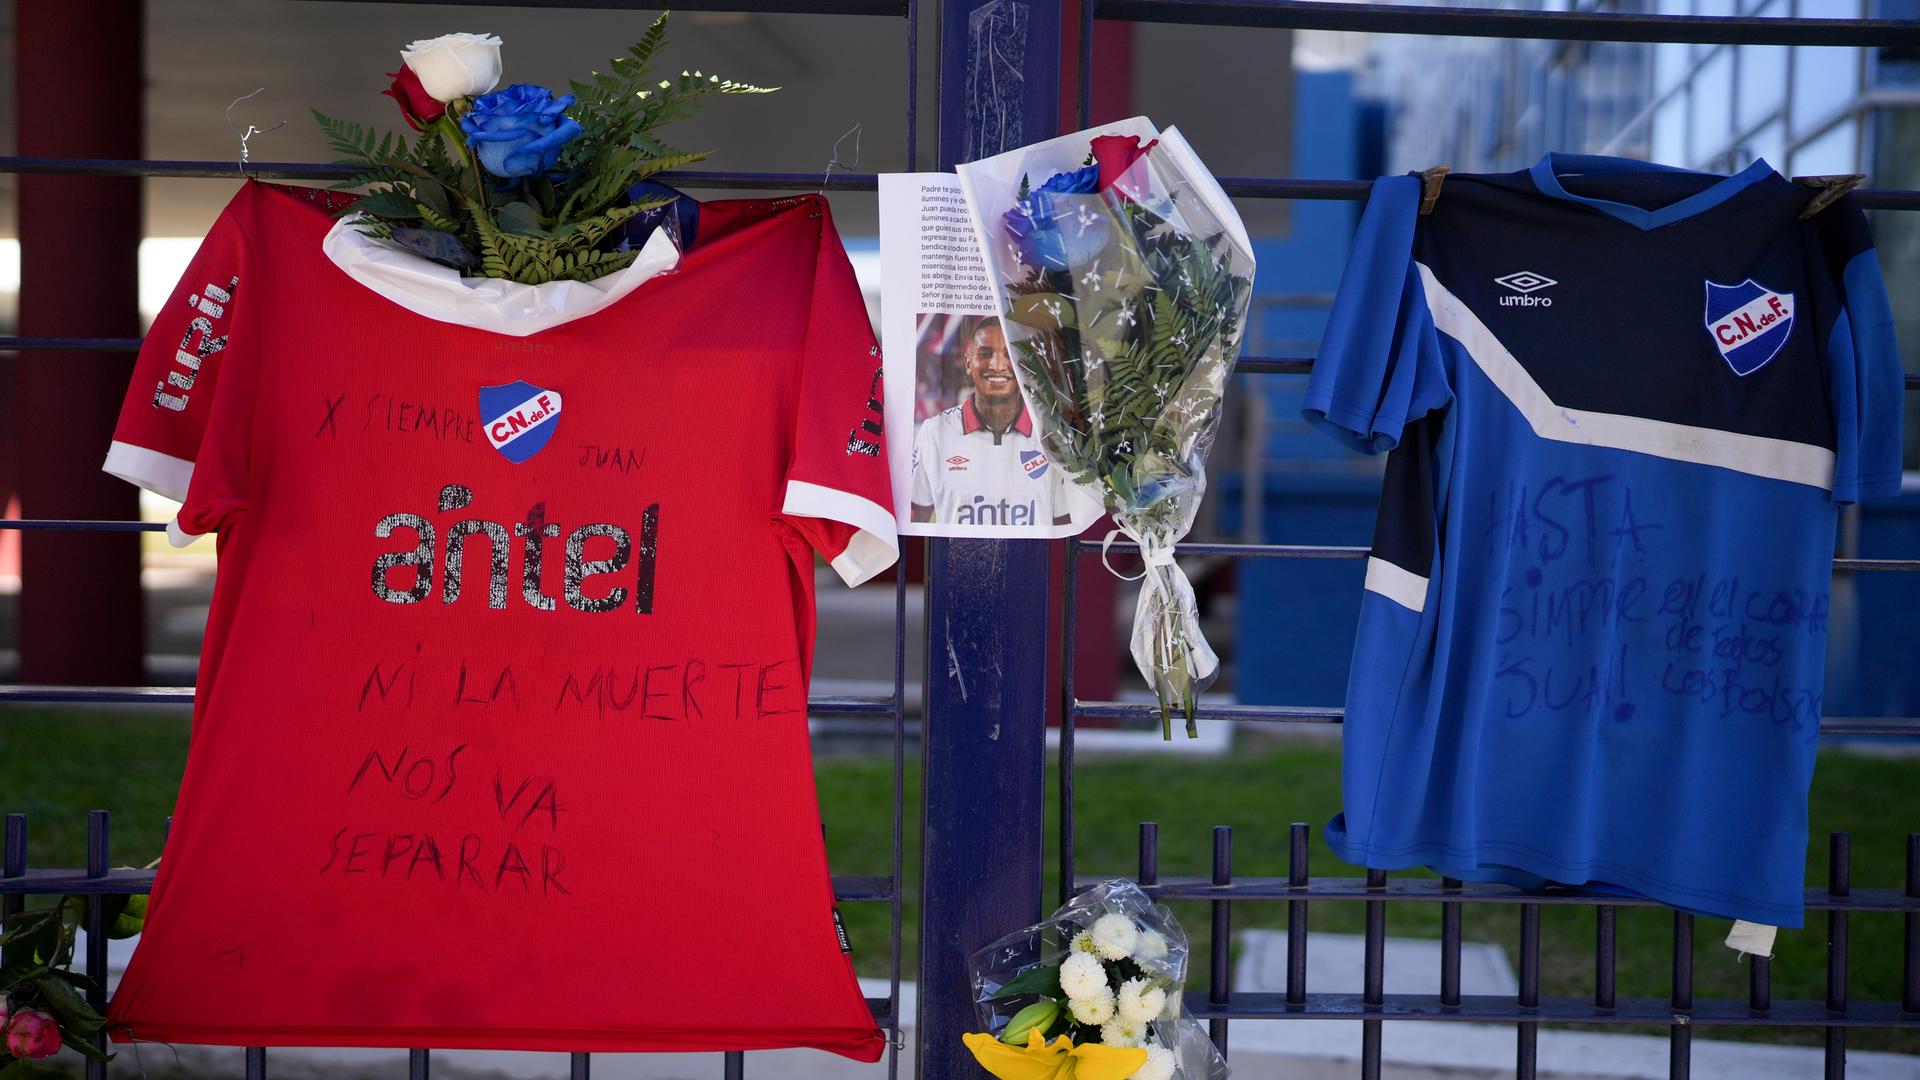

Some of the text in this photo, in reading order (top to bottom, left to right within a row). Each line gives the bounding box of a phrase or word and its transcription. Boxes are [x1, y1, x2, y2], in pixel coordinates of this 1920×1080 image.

[1499, 294, 1552, 308] umbro
[314, 393, 474, 443] X SIEMPRE
[578, 445, 646, 474] JUAN
[957, 495, 1036, 526] antel
[1484, 472, 1664, 573] HASTA
[371, 484, 660, 615] antel
[455, 658, 519, 710] LA
[556, 658, 803, 725] MUERTE
[347, 744, 571, 831] NOS VA
[320, 827, 571, 897] SEPARAR
